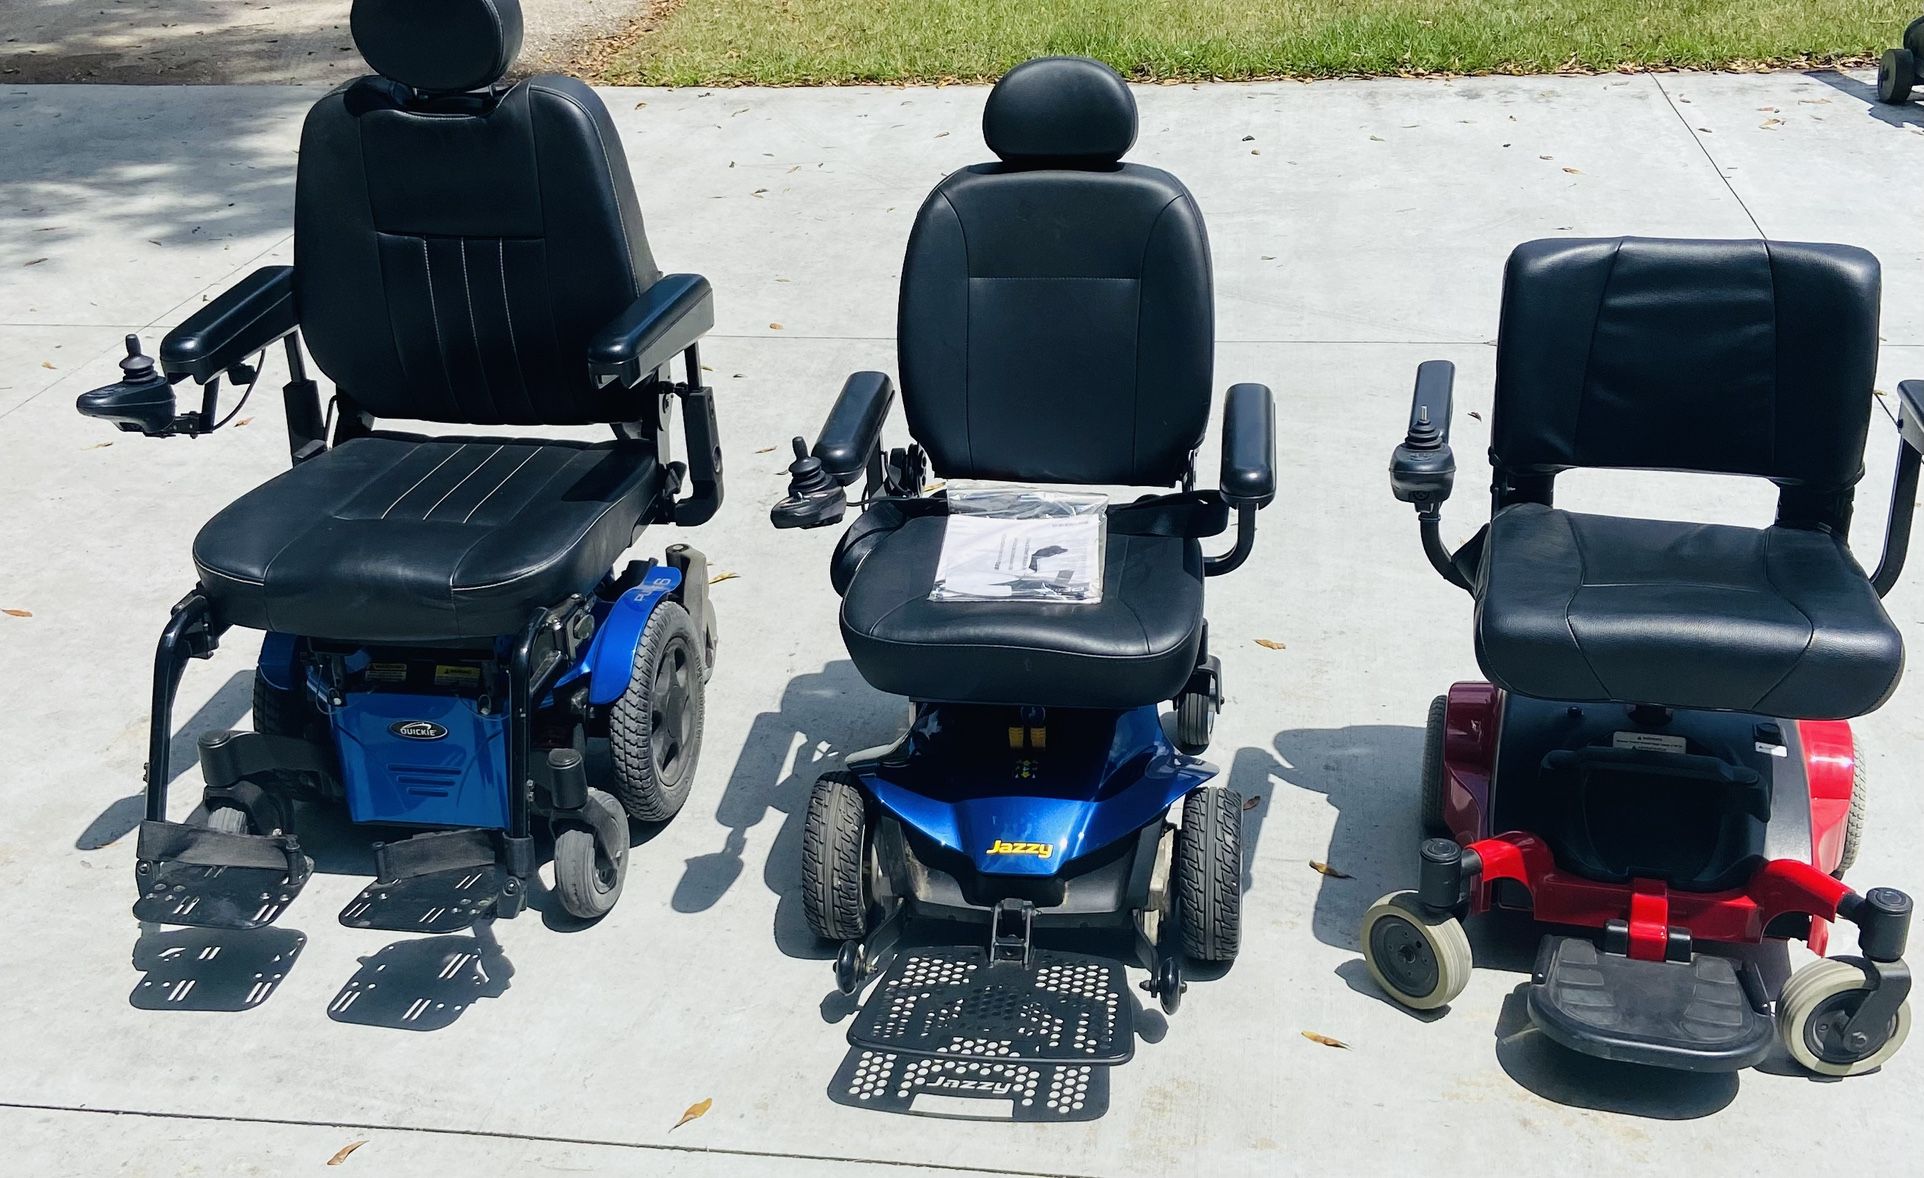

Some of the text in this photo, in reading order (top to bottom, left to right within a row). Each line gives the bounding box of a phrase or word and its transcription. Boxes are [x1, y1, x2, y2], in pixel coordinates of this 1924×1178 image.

[400, 728, 436, 736] QUICKIE
[986, 839, 1054, 859] Jazzy
[926, 1076, 1011, 1094] Jazzy
